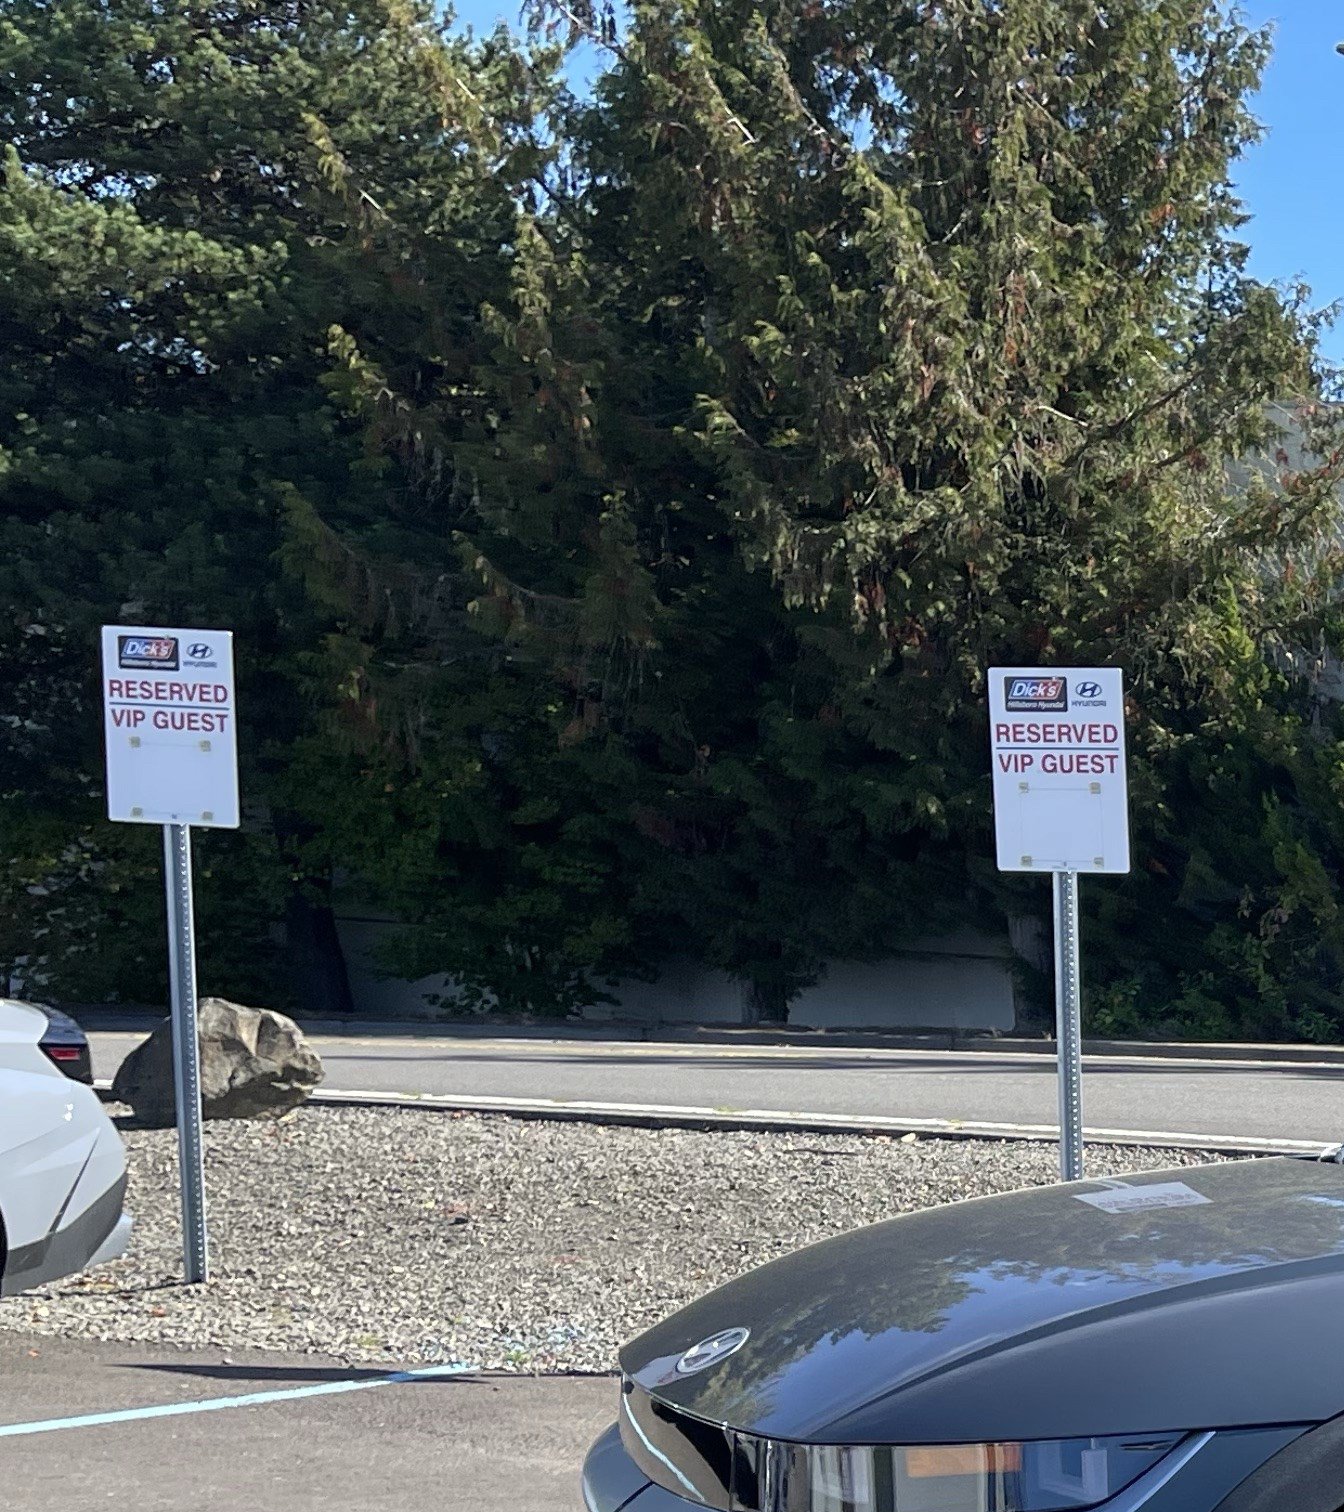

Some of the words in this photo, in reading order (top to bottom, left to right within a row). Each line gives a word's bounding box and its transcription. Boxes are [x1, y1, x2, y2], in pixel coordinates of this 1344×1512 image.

[109, 679, 228, 704] RESERVED
[1012, 680, 1057, 697] Dick's
[111, 708, 146, 728] VIP
[153, 710, 228, 733] GUEST
[995, 723, 1118, 744] RESERVED
[998, 753, 1034, 773] VIP
[1041, 754, 1119, 774] GUEST
